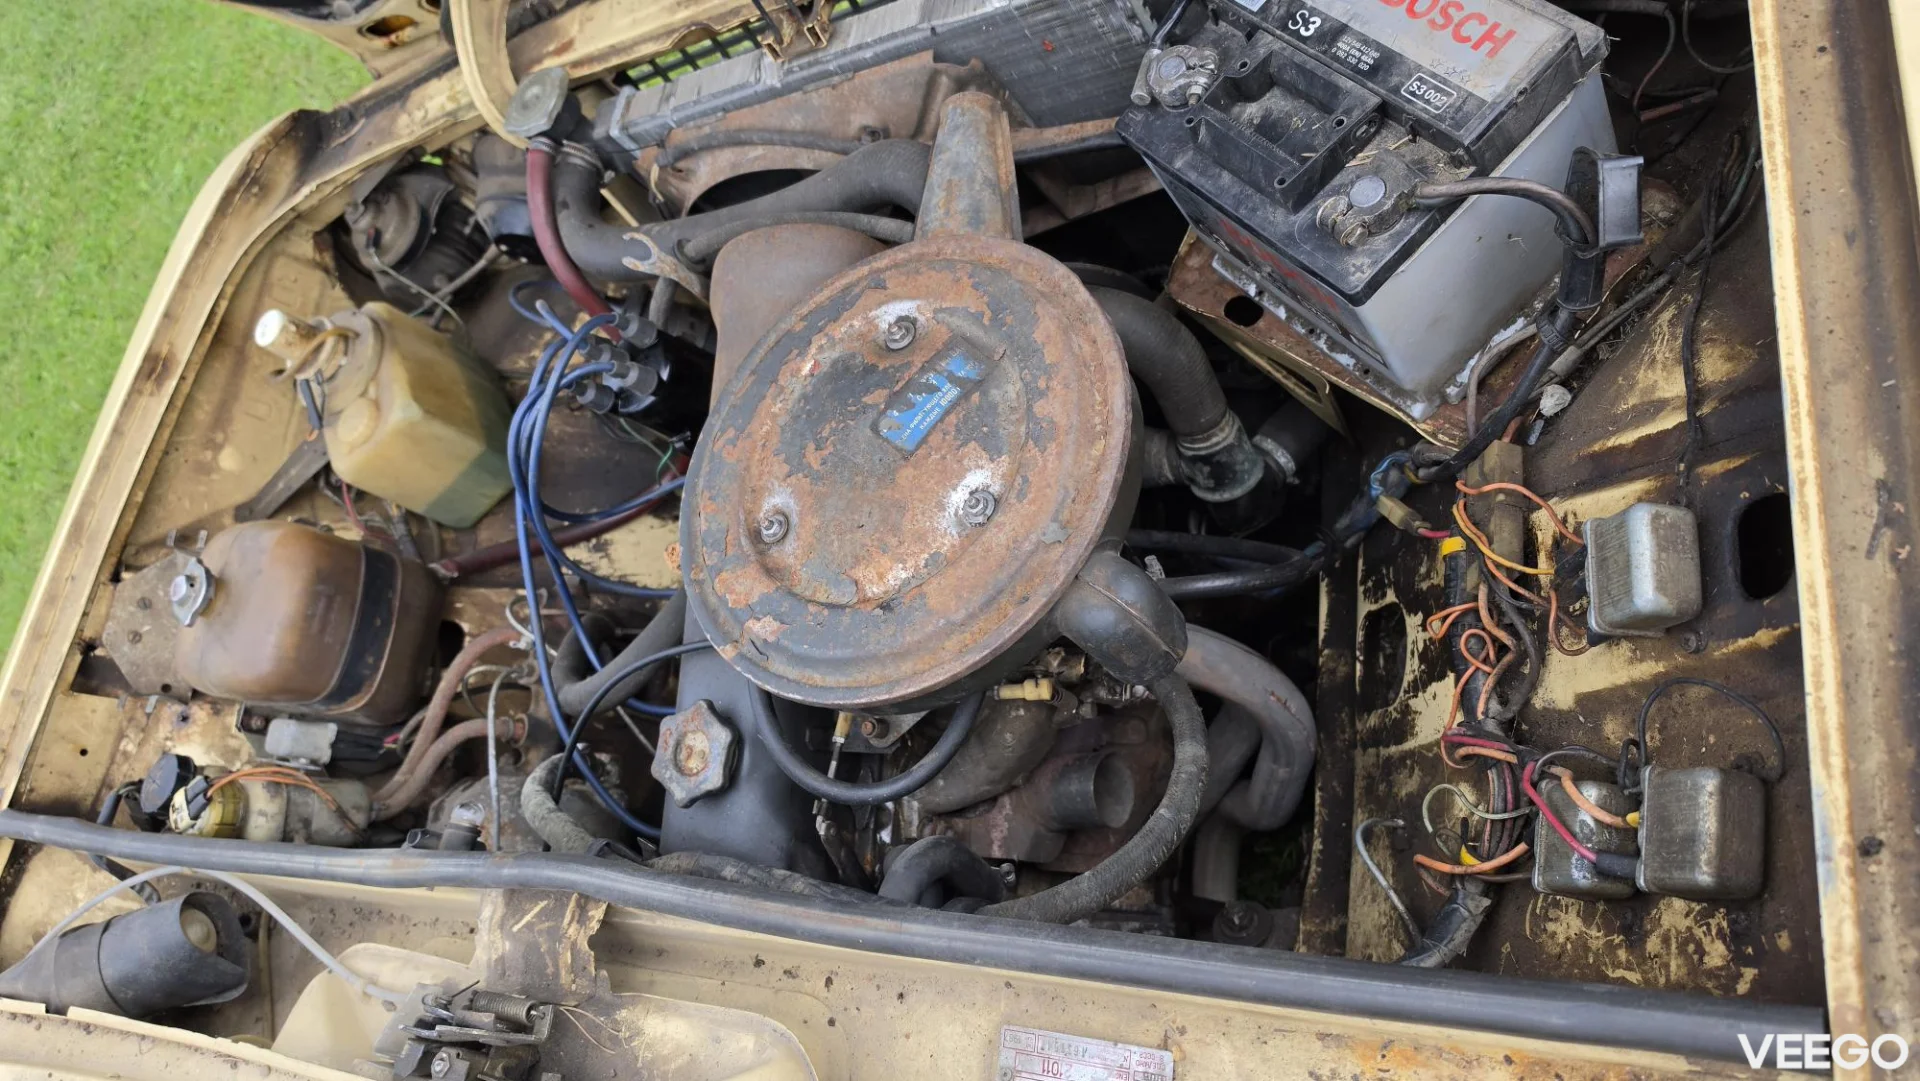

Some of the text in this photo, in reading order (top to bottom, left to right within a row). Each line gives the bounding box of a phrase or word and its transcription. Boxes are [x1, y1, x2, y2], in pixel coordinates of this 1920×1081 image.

[1288, 10, 1321, 36] S3
[1378, 0, 1516, 59] OSCH
[1409, 81, 1447, 107] S3 002
